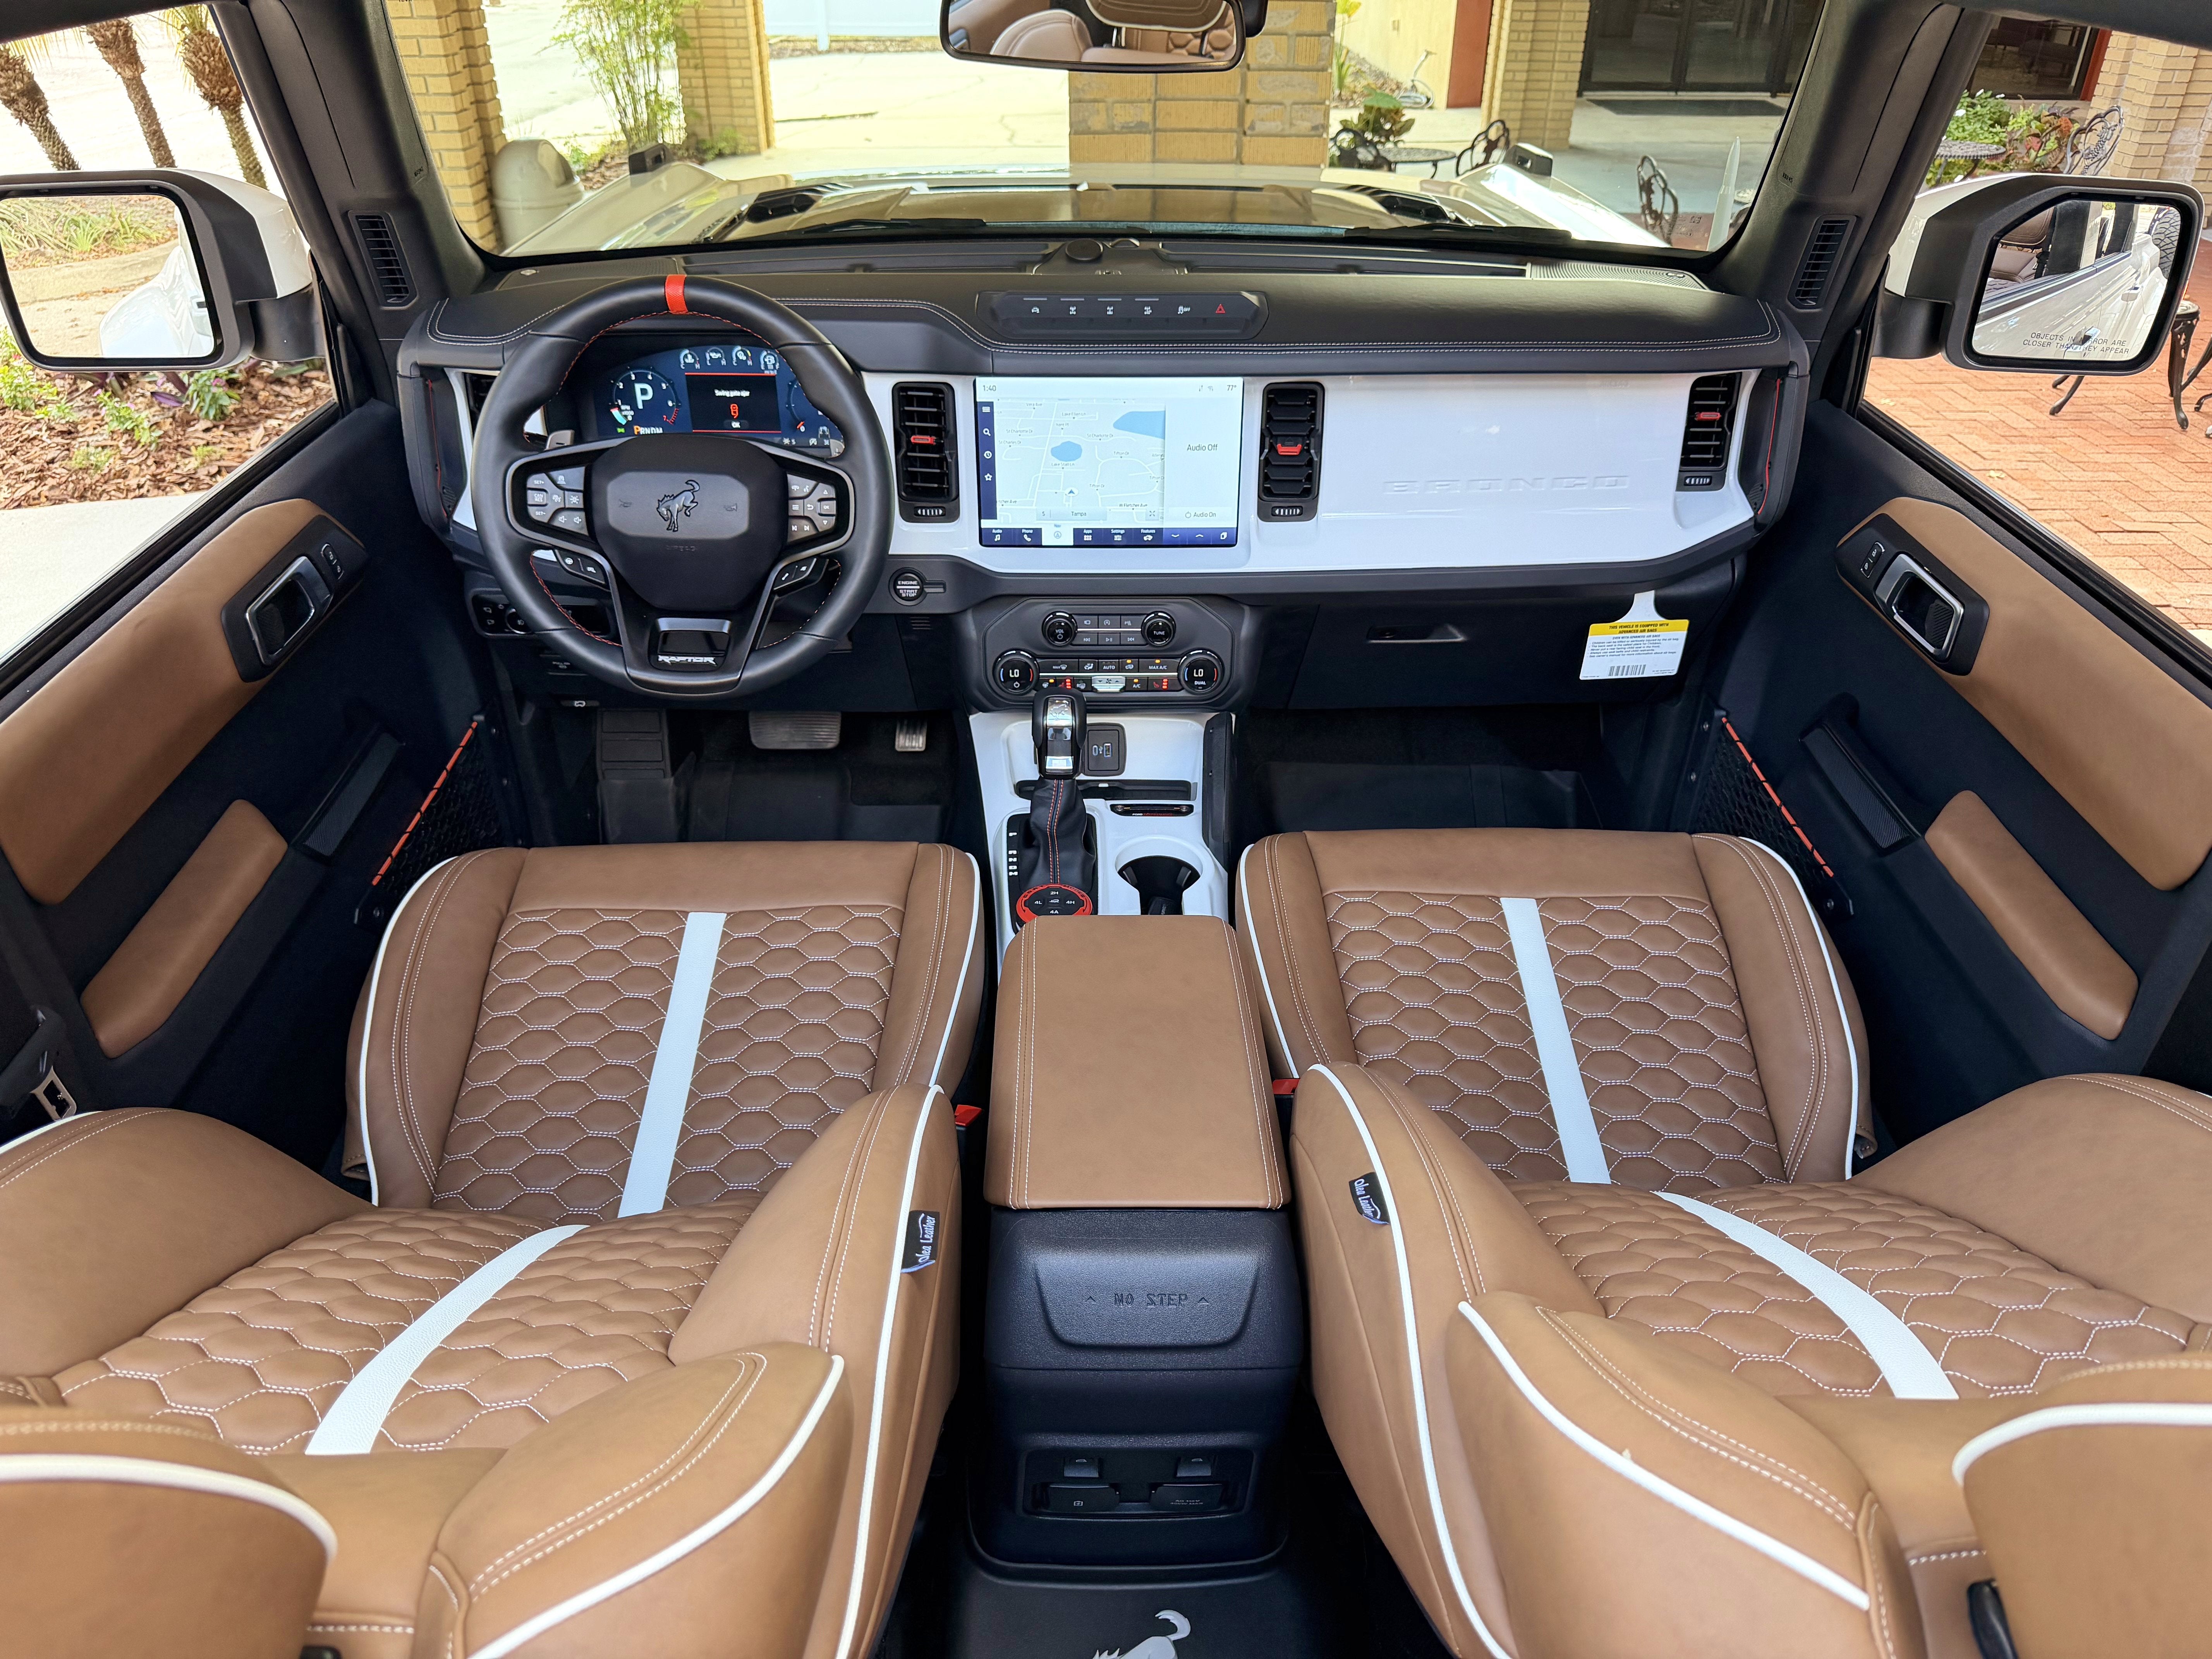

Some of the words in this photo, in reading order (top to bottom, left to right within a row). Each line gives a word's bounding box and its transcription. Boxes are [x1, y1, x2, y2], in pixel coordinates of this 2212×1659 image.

[2031, 333, 2064, 341] OBJECTS
[634, 383, 653, 409] P
[1382, 476, 1629, 494] BRONCO
[658, 655, 717, 666] RAPTOR
[1009, 669, 1019, 677] LO
[1194, 669, 1204, 677] LO
[920, 1215, 936, 1243] Leather
[1114, 1293, 1134, 1307] NO
[1146, 1293, 1188, 1307] STEP
